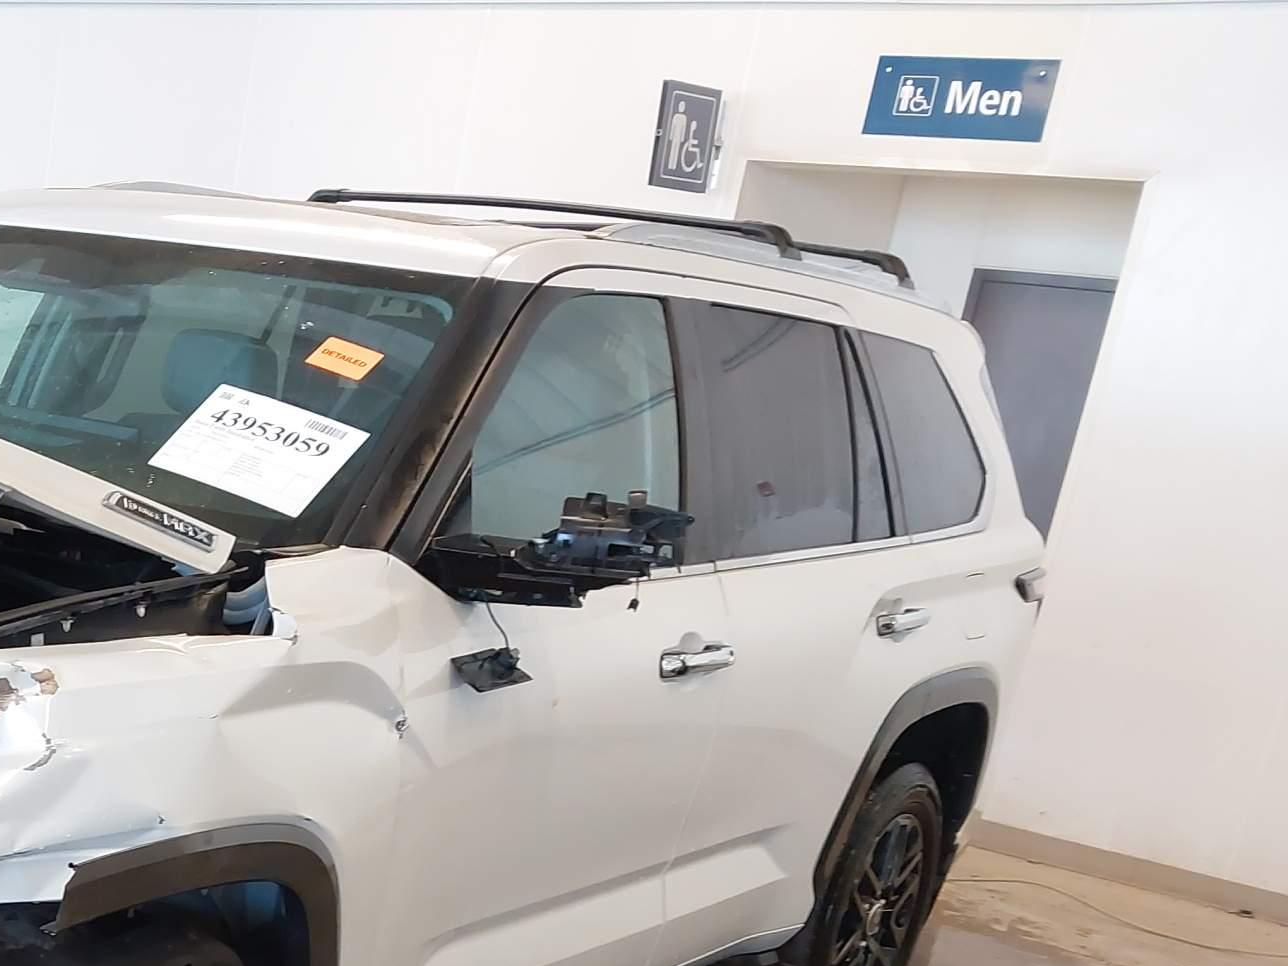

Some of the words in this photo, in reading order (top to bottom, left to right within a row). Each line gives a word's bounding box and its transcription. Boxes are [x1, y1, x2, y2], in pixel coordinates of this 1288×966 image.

[944, 81, 1023, 116] Men
[321, 348, 368, 368] DETAILED
[210, 409, 330, 457] 43953059
